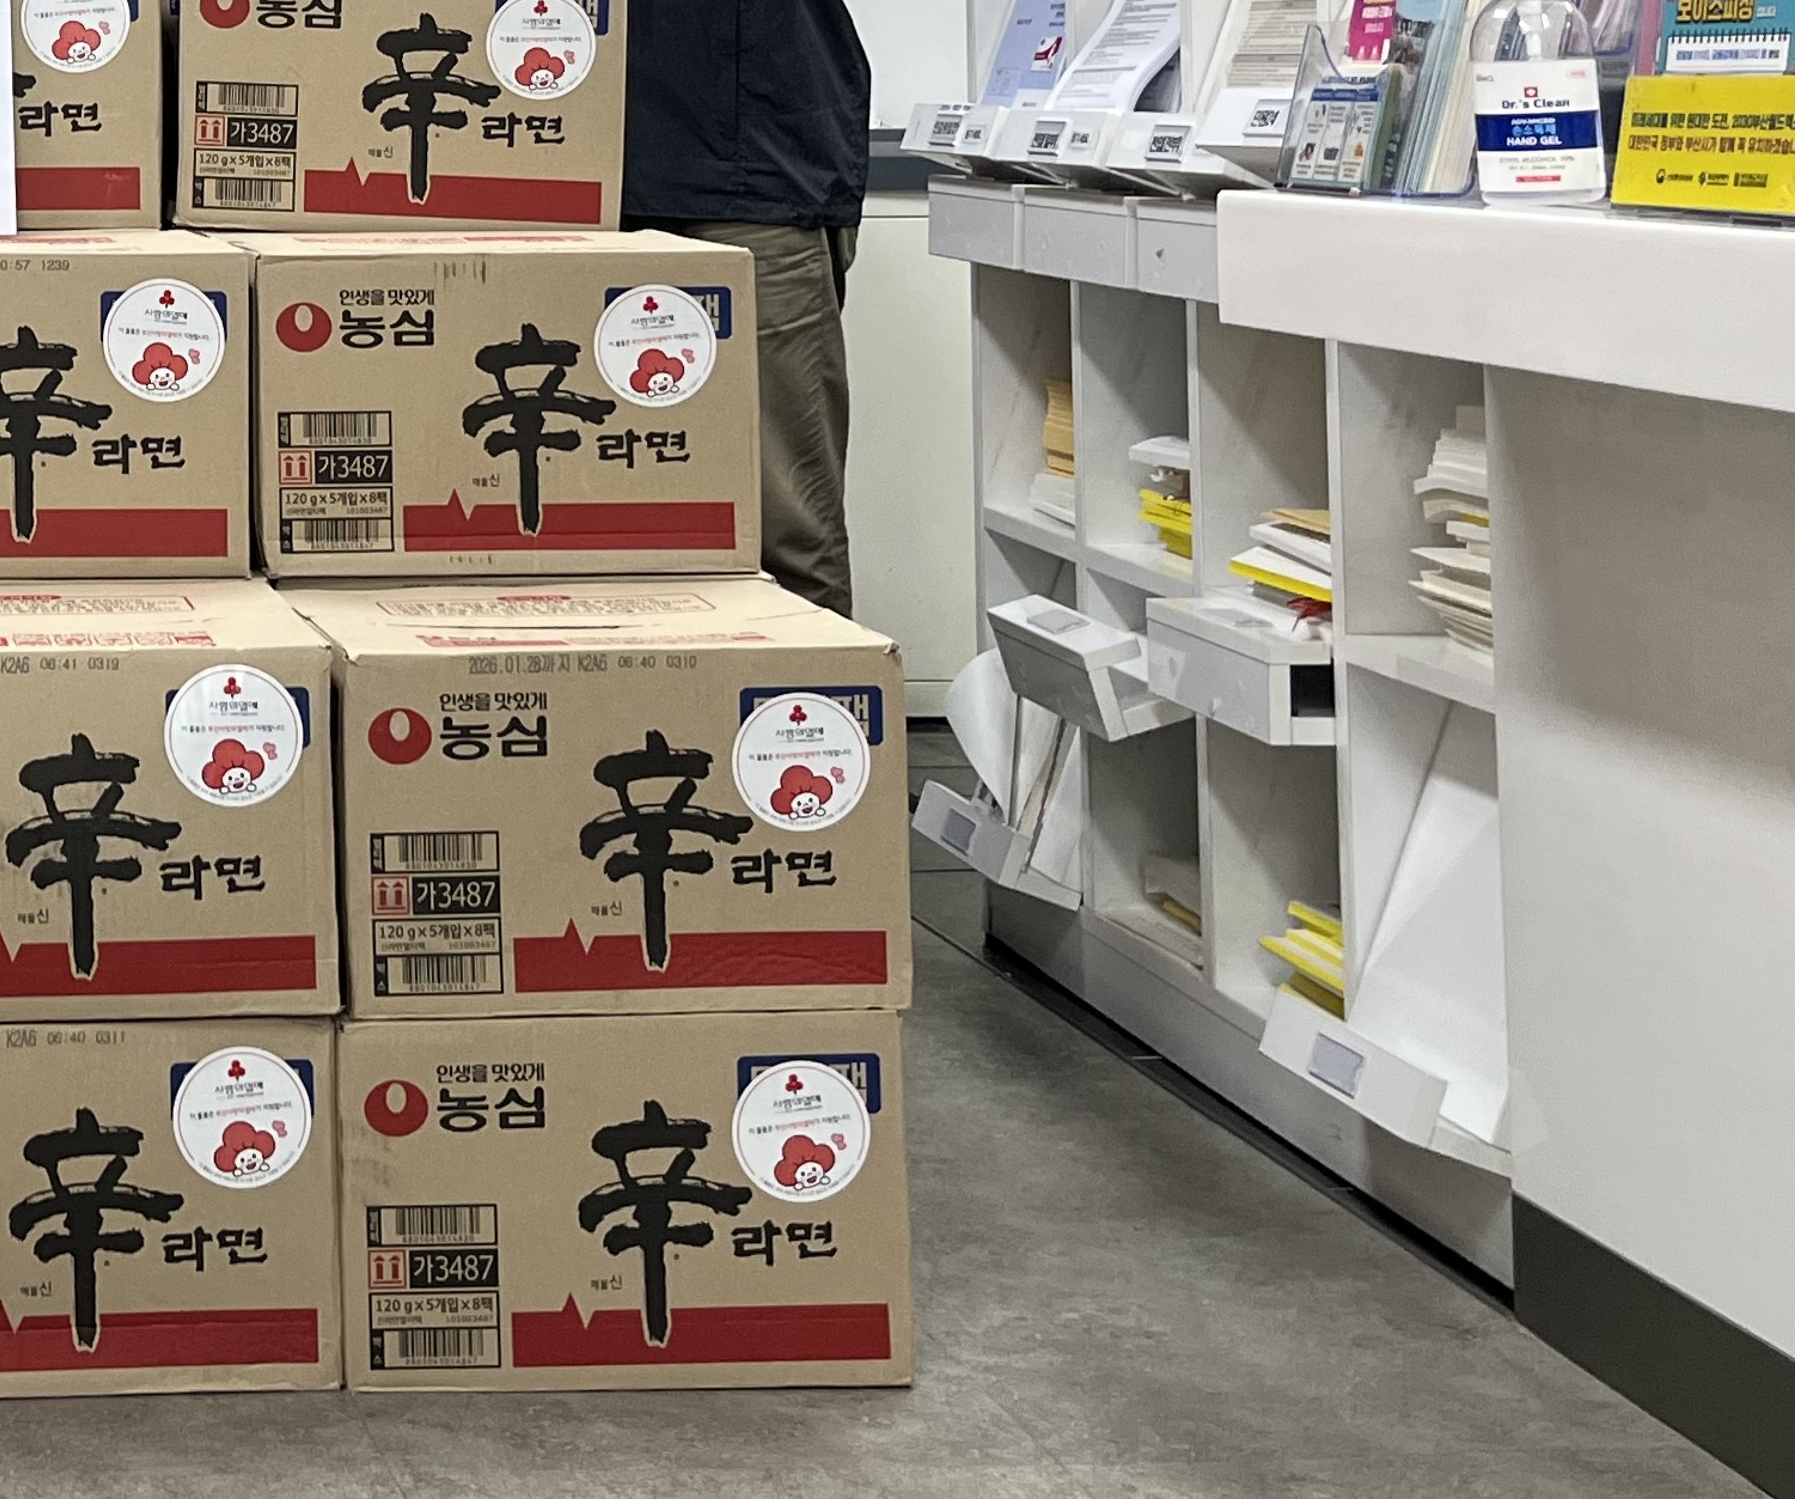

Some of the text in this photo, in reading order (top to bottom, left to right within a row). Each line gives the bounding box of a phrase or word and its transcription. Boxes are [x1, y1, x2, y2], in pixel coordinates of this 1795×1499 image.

[18, 102, 102, 137] 라면
[362, 13, 501, 202] 辛
[1534, 99, 1569, 108] Clean
[230, 122, 294, 144] 가3487
[481, 113, 566, 147] 라면
[1507, 136, 1563, 146] HAND GEL
[340, 290, 435, 305] 인생을 맛있게
[340, 310, 435, 348] 농심
[462, 323, 616, 534] 辛
[92, 433, 186, 474] 라면
[318, 455, 388, 480] 가3487
[597, 430, 690, 468] 라면
[439, 692, 547, 710] 인생을 맛있게
[439, 715, 547, 761] 농심
[6, 733, 182, 976] 辛
[580, 729, 753, 969] 辛
[159, 854, 266, 900] 라면
[731, 850, 837, 893] 라면
[417, 880, 495, 909] 가3487
[436, 1063, 545, 1082] 인생을 맛있게
[437, 1087, 546, 1132] 농심
[10, 1107, 184, 1351] 辛
[579, 1100, 752, 1346] 辛
[731, 1220, 837, 1265] 라면
[162, 1227, 267, 1270] 라면
[414, 1254, 493, 1282] 가3487
